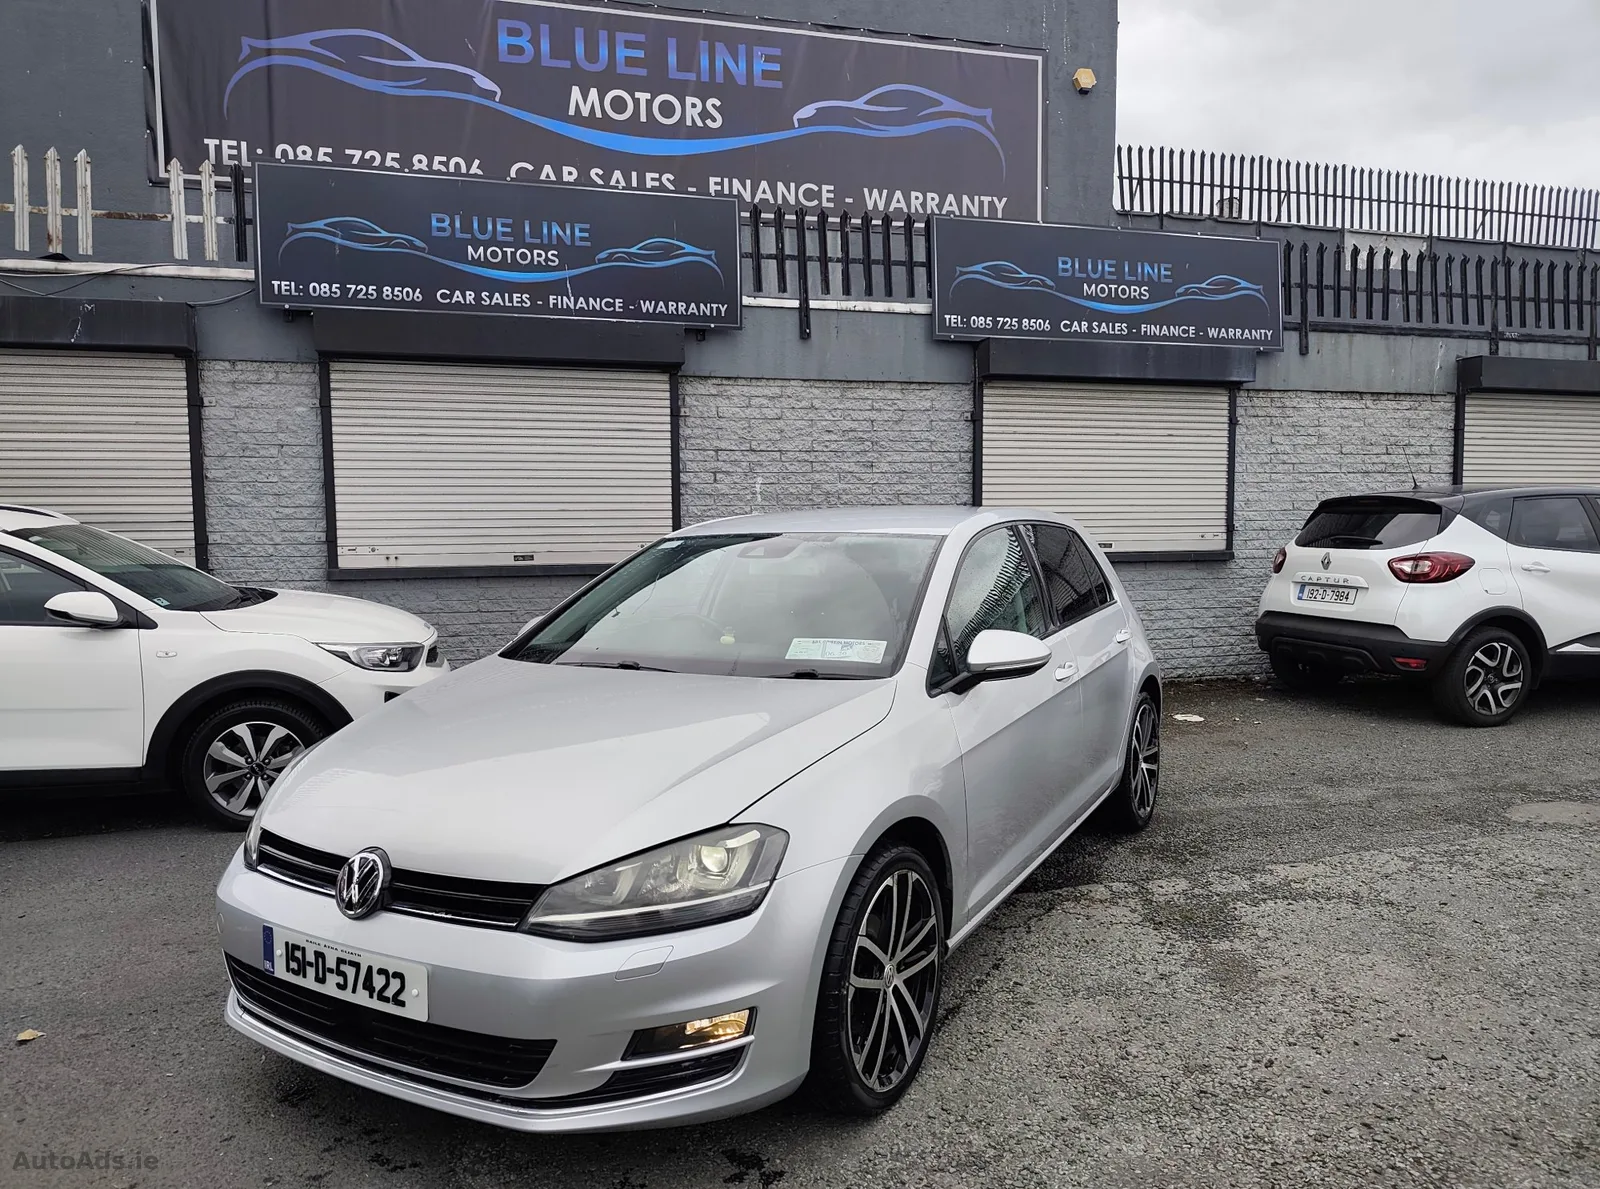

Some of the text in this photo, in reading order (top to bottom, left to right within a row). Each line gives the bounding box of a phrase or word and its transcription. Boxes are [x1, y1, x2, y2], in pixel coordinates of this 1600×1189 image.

[497, 18, 783, 89] BLUE LINE
[568, 85, 723, 129] MOTORS
[510, 162, 578, 182] CAR
[709, 176, 834, 208] FINANCE
[863, 187, 1008, 218] WARRANTY
[430, 212, 592, 247] BLUE LINE
[467, 245, 560, 266] MOTORS
[1057, 256, 1173, 283] BLUE LINE
[271, 280, 304, 296] TEL:
[308, 282, 341, 298] 085
[346, 284, 378, 299] 725
[382, 286, 423, 302] 8506
[436, 289, 476, 305] CAR
[481, 291, 531, 307] SALES
[549, 295, 624, 312] FINANCE
[640, 300, 728, 317] WARRANTY
[1083, 283, 1150, 300] MOTORS
[944, 315, 967, 328] TEL:
[970, 316, 993, 329] 085
[997, 317, 1019, 330] 725
[1021, 318, 1051, 332] 8506
[1060, 320, 1089, 333] CAR
[1092, 321, 1128, 335] SALES
[1141, 324, 1196, 338] FINANCE
[1208, 327, 1273, 341] WARRANTY
[1300, 575, 1350, 584] CAPTUR
[1306, 588, 1350, 602] 192-D-7984
[285, 940, 406, 1008] 151-D-57422
